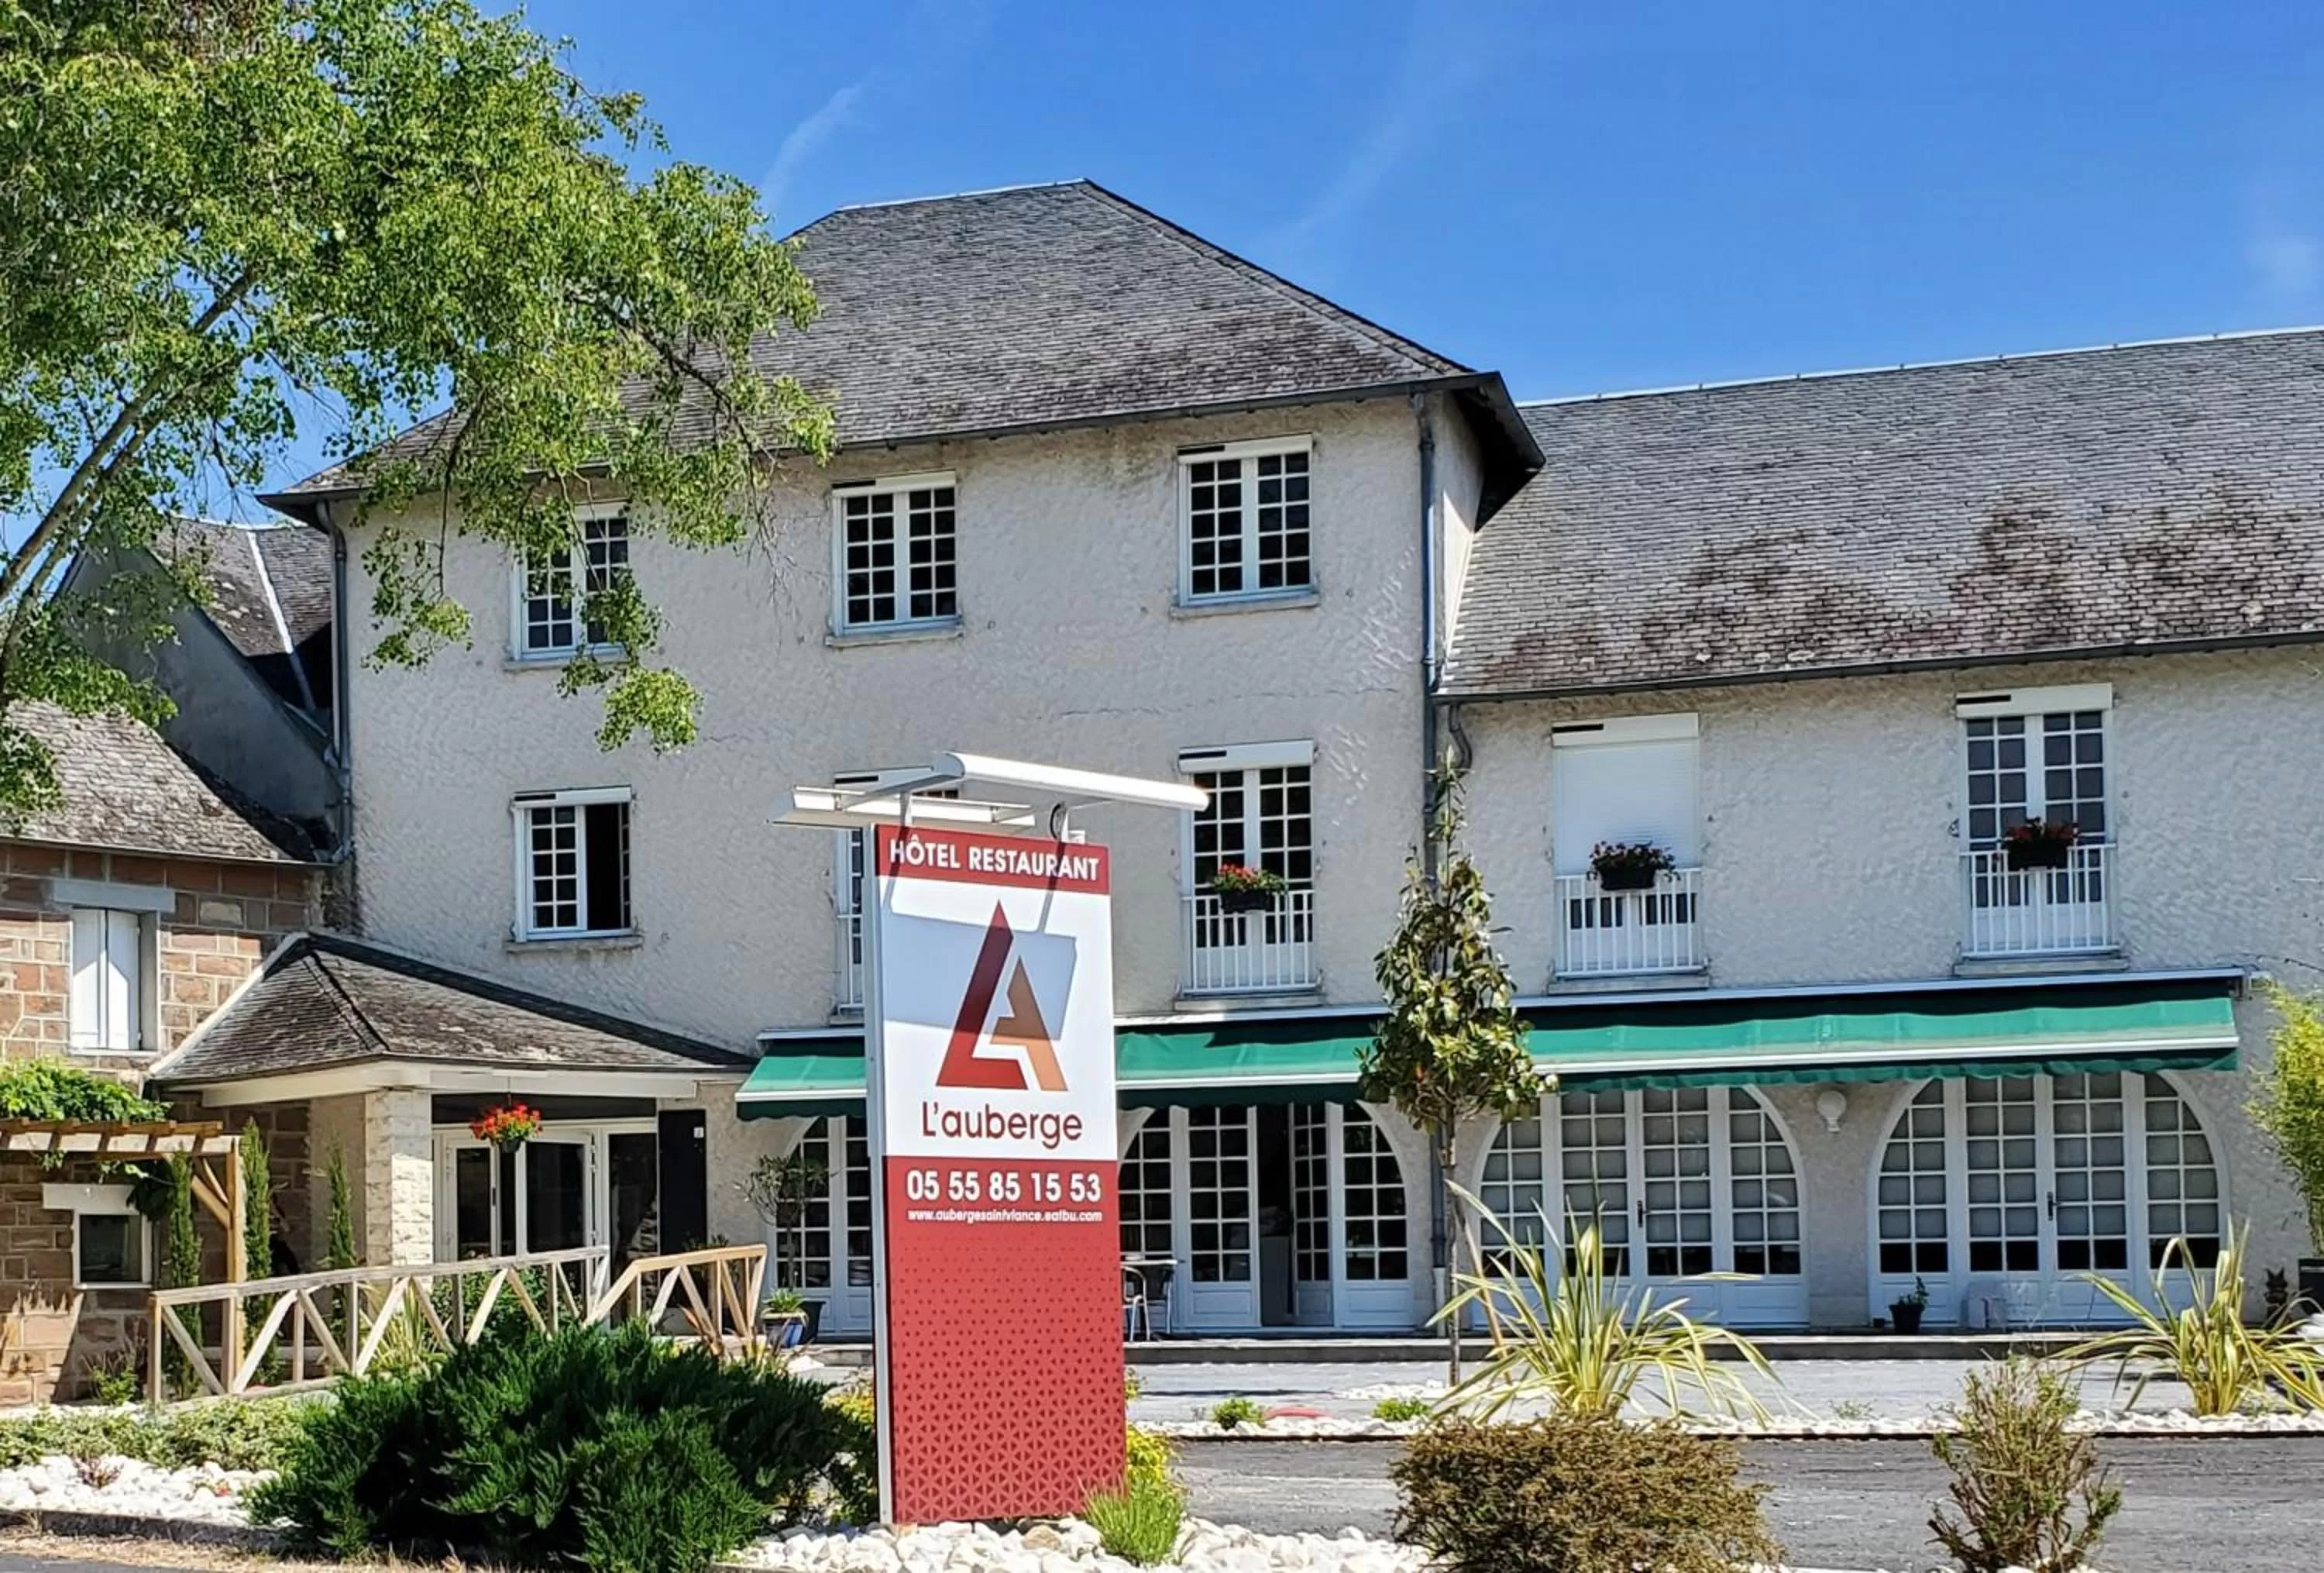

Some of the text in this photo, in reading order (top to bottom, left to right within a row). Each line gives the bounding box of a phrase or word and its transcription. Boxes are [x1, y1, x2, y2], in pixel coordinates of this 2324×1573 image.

[890, 835, 1099, 880] HÔTEL RESTAURANT
[922, 1101, 1082, 1149] L'auberge
[907, 1170, 1102, 1202] 05 55 85 15 53
